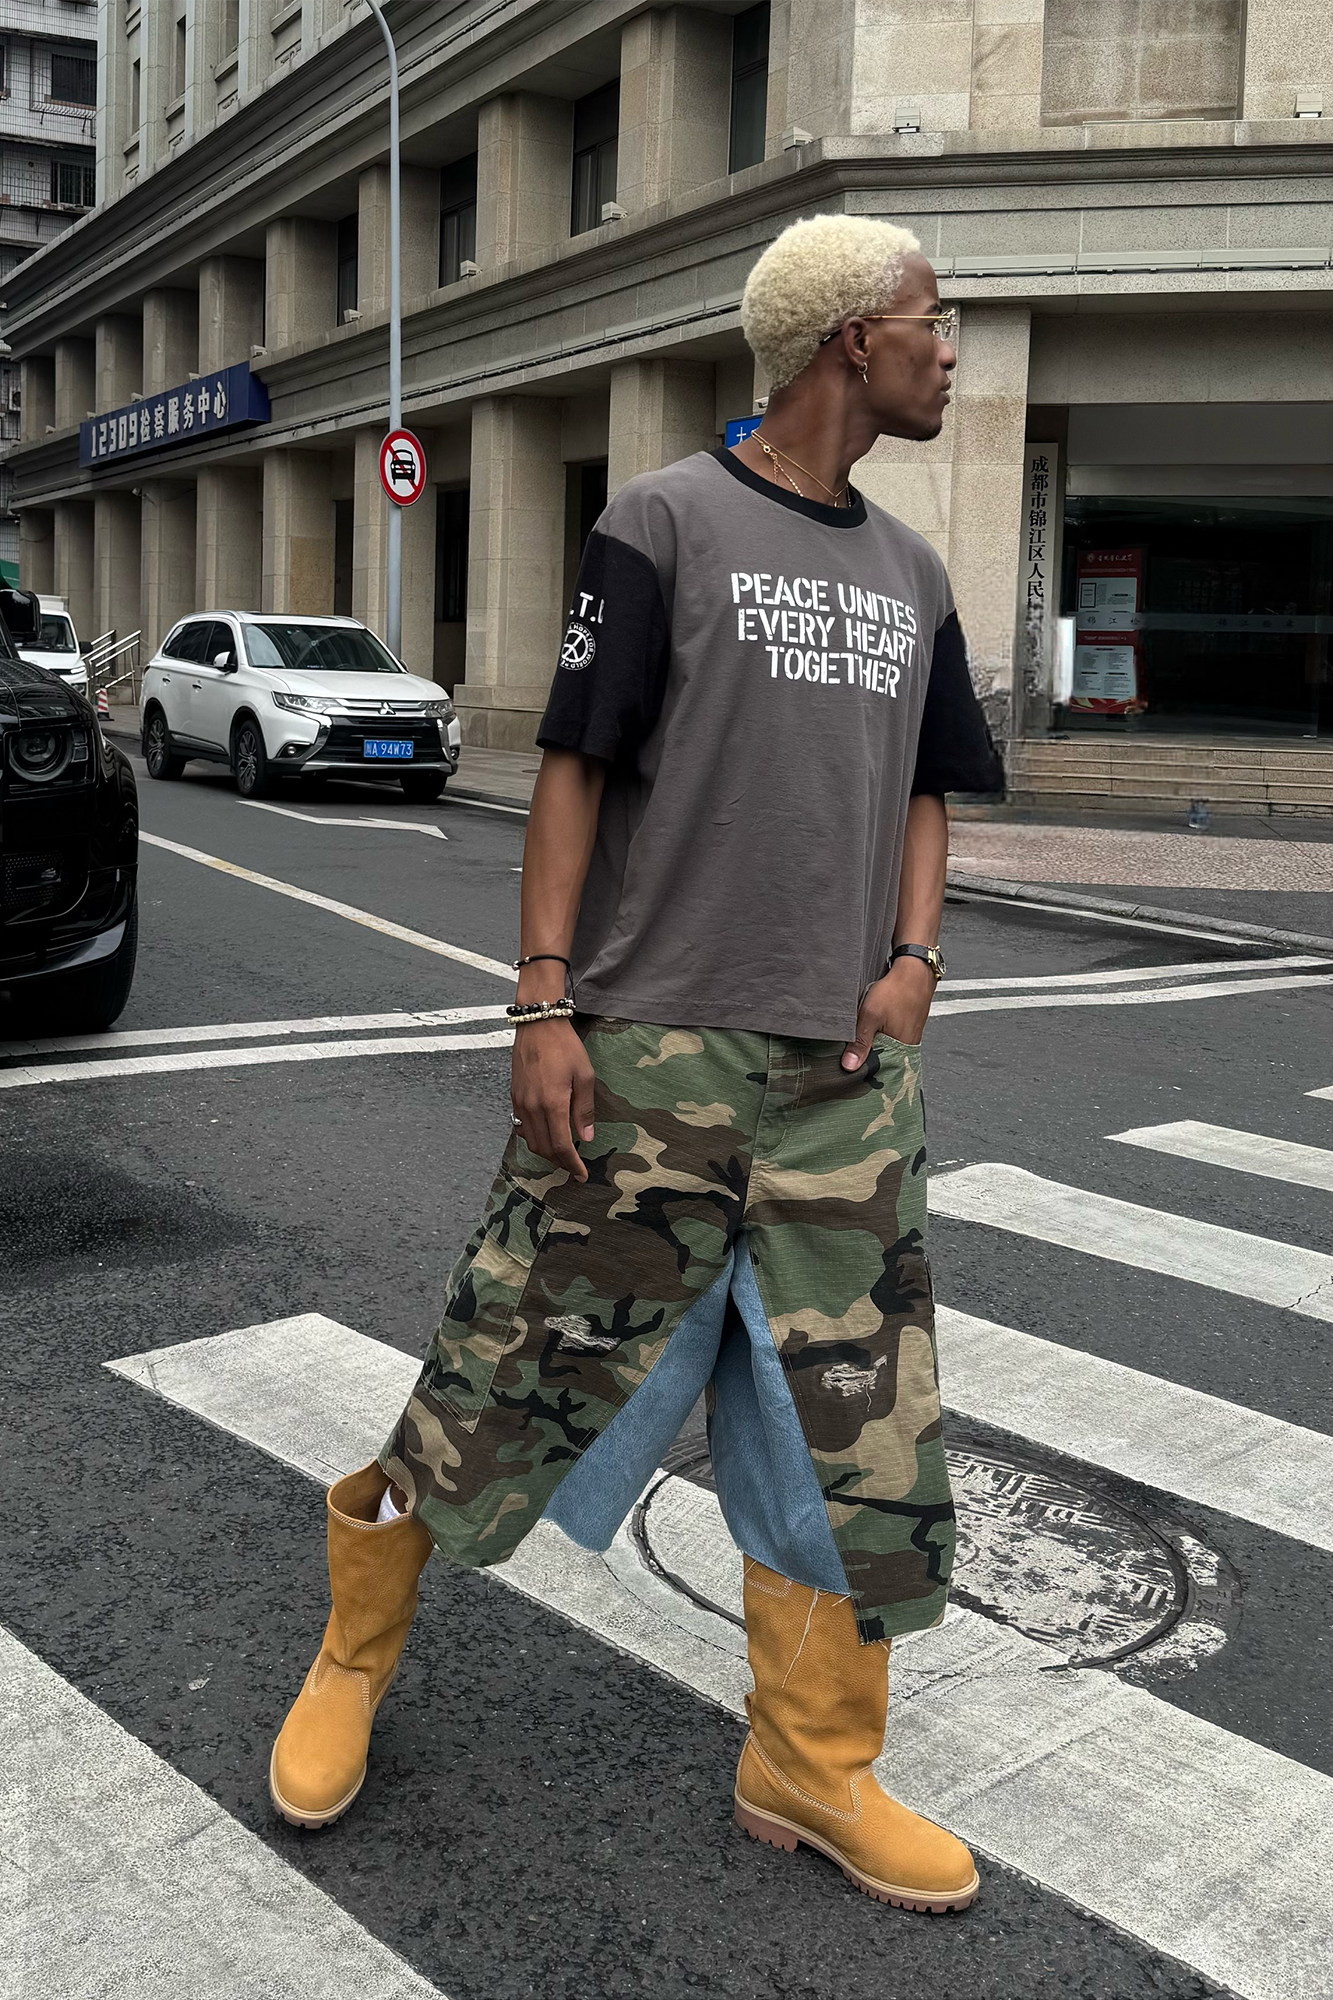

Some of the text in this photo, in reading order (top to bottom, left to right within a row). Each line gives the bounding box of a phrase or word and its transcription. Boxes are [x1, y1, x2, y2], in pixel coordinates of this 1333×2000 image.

[91, 381, 227, 459] 12309检察服务中心
[731, 573, 917, 634] PEACE UNITES
[738, 608, 916, 668] EVERY HEART
[765, 645, 901, 698] TOGETHER
